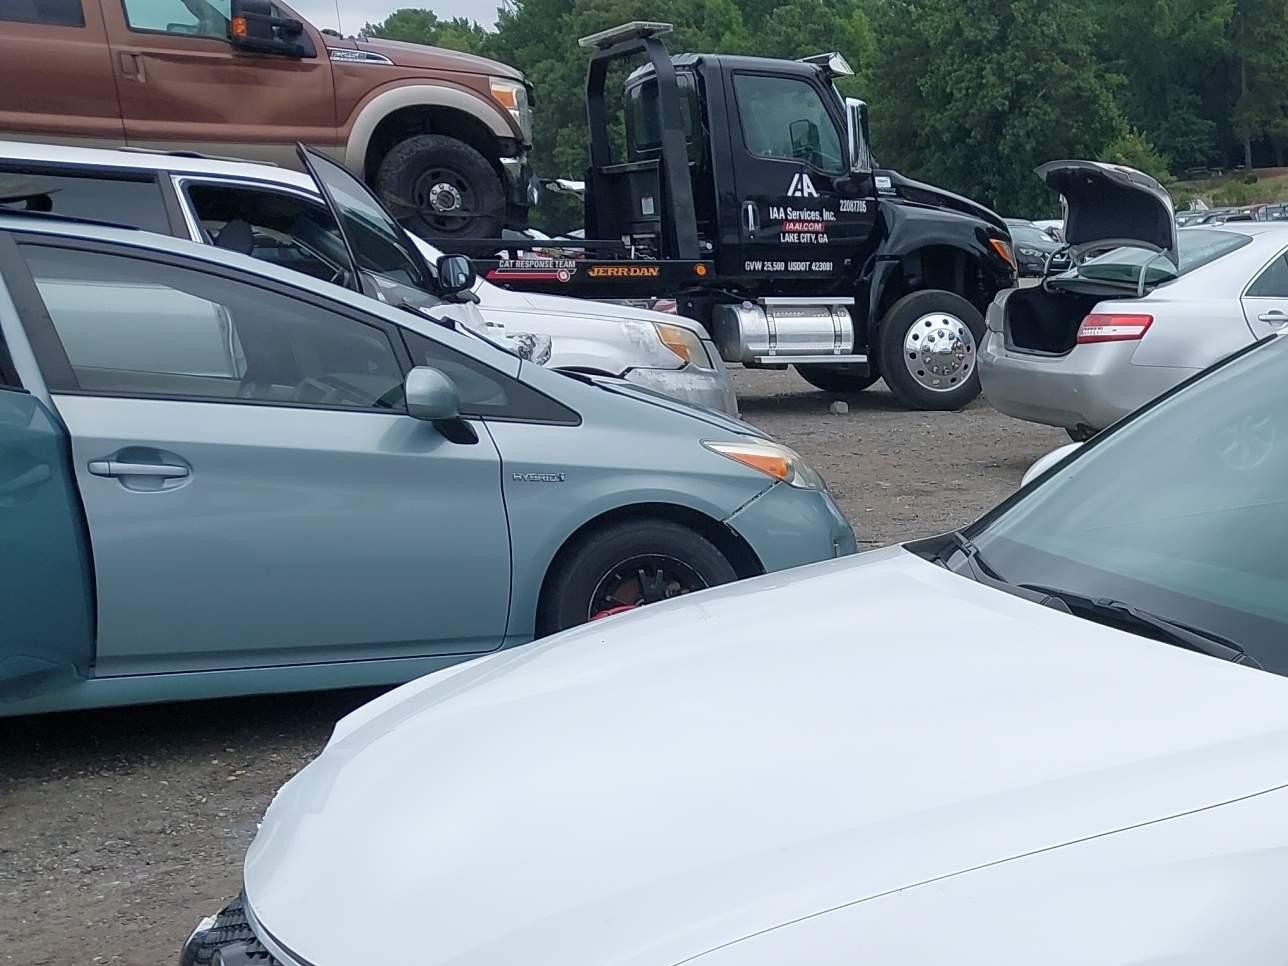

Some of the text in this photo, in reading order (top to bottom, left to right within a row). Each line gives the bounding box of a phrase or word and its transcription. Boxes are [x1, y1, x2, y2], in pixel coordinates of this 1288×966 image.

[769, 206, 837, 221] IAA Services, Inc.
[785, 222, 823, 231] IAAI.COM
[780, 233, 829, 244] LAKE CITY, GA
[499, 260, 576, 268] CAT RESPONSE TEAM
[744, 261, 763, 271] GVW
[764, 261, 785, 272] 25,500
[788, 261, 811, 271] USDOT
